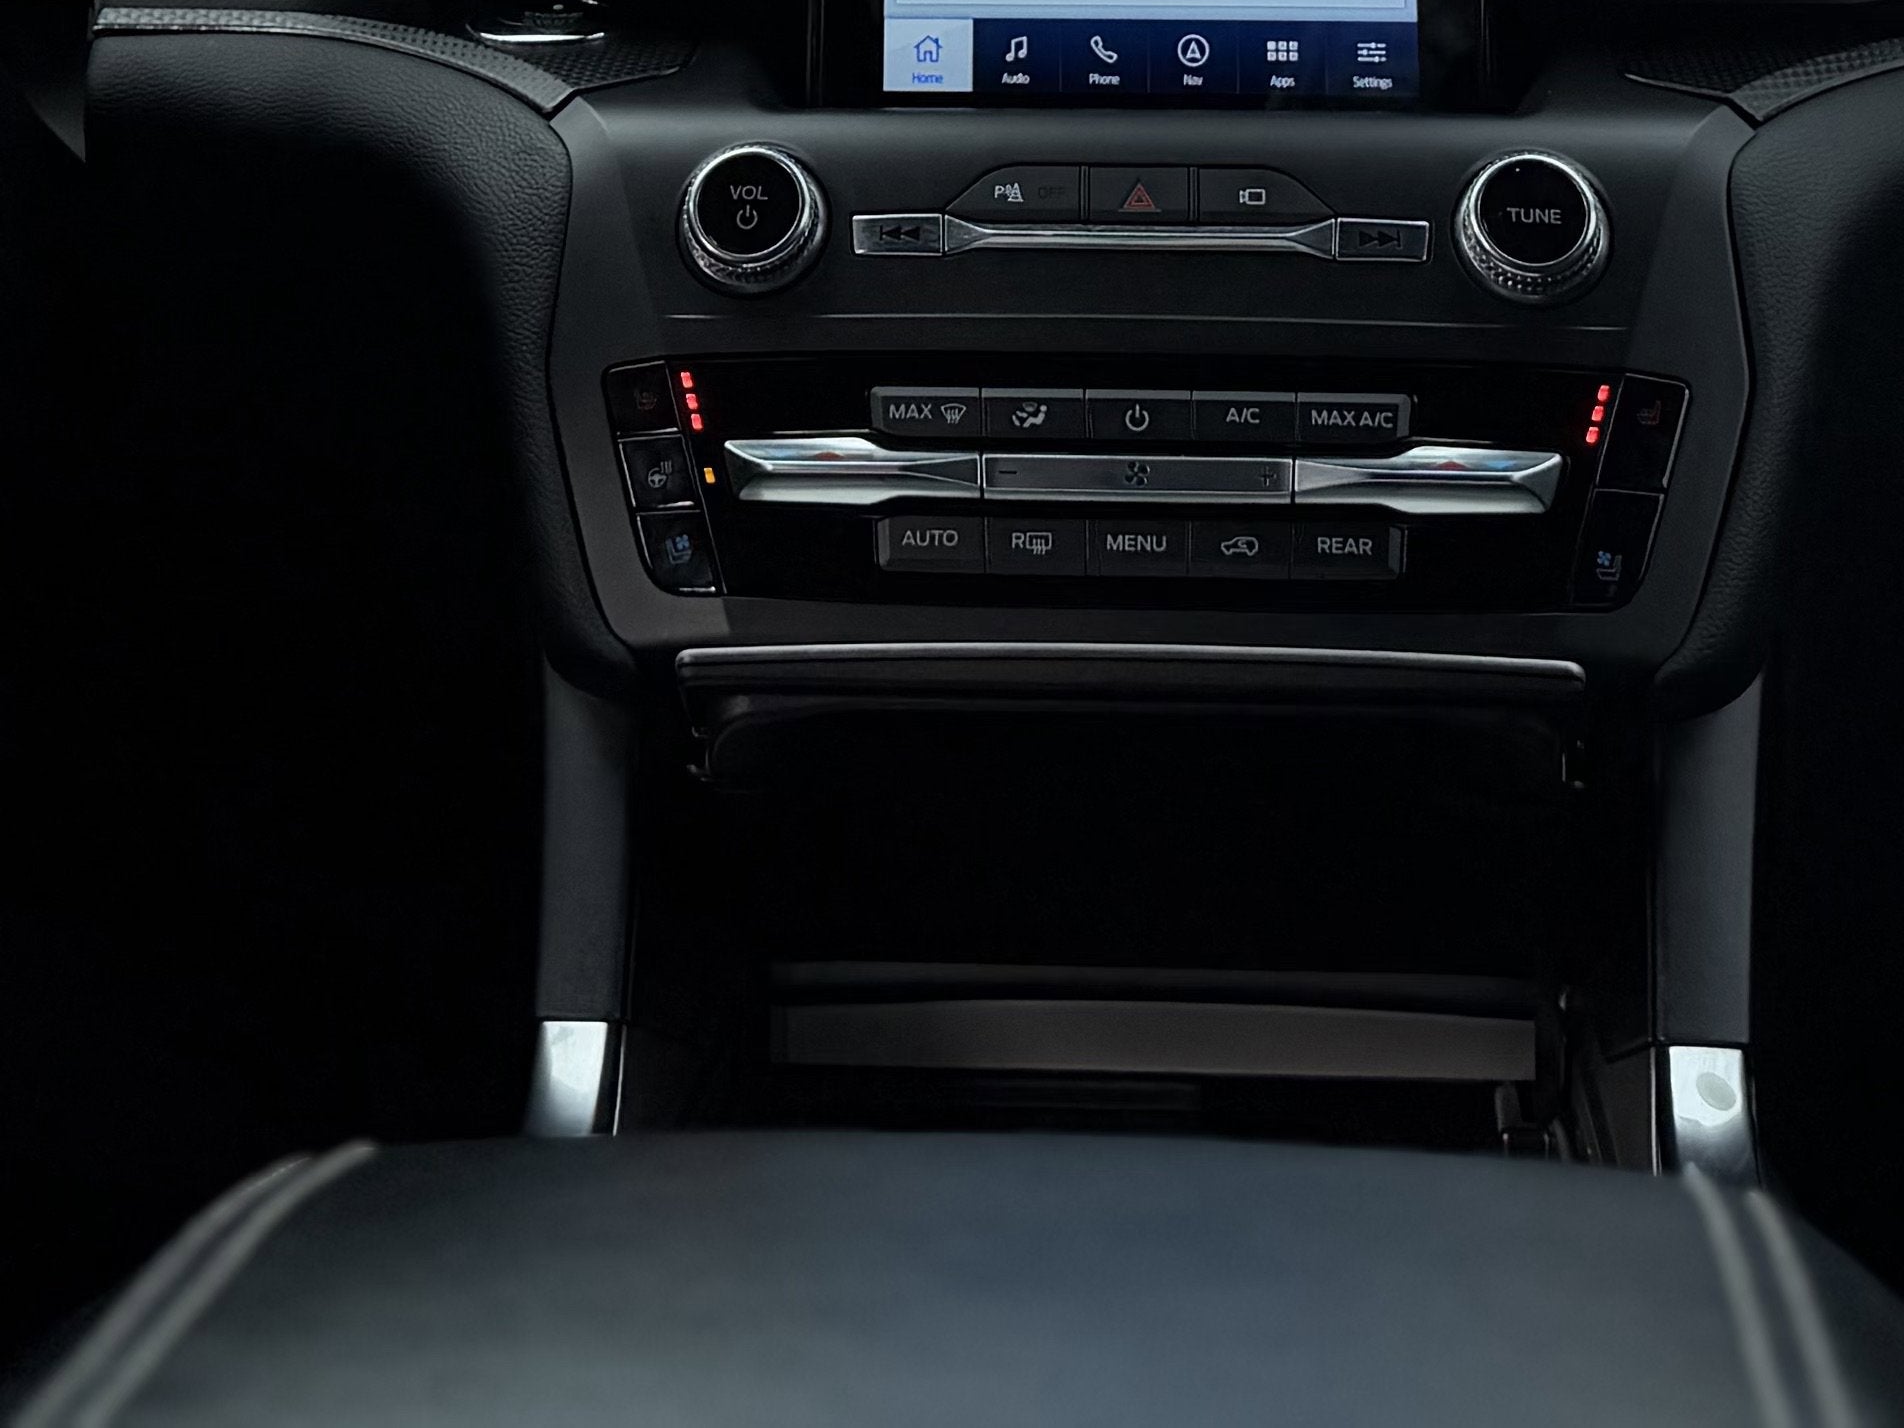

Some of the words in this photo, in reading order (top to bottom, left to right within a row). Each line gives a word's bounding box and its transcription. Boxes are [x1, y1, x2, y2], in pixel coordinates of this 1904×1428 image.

[911, 73, 944, 85] Home
[1001, 73, 1030, 85] Audio
[1088, 73, 1121, 86] Phone
[1183, 74, 1204, 86] Nav
[1270, 75, 1296, 88] Apps
[1352, 75, 1393, 90] Settings
[729, 184, 769, 201] VOL
[1505, 206, 1563, 225] TUNE
[888, 402, 932, 421] MAX
[1224, 406, 1261, 426] A/C
[1310, 408, 1354, 428] MAX
[1359, 409, 1395, 429] A/C
[900, 528, 960, 549] AUTO
[1105, 534, 1168, 553] MENU
[1316, 536, 1374, 556] REAR
